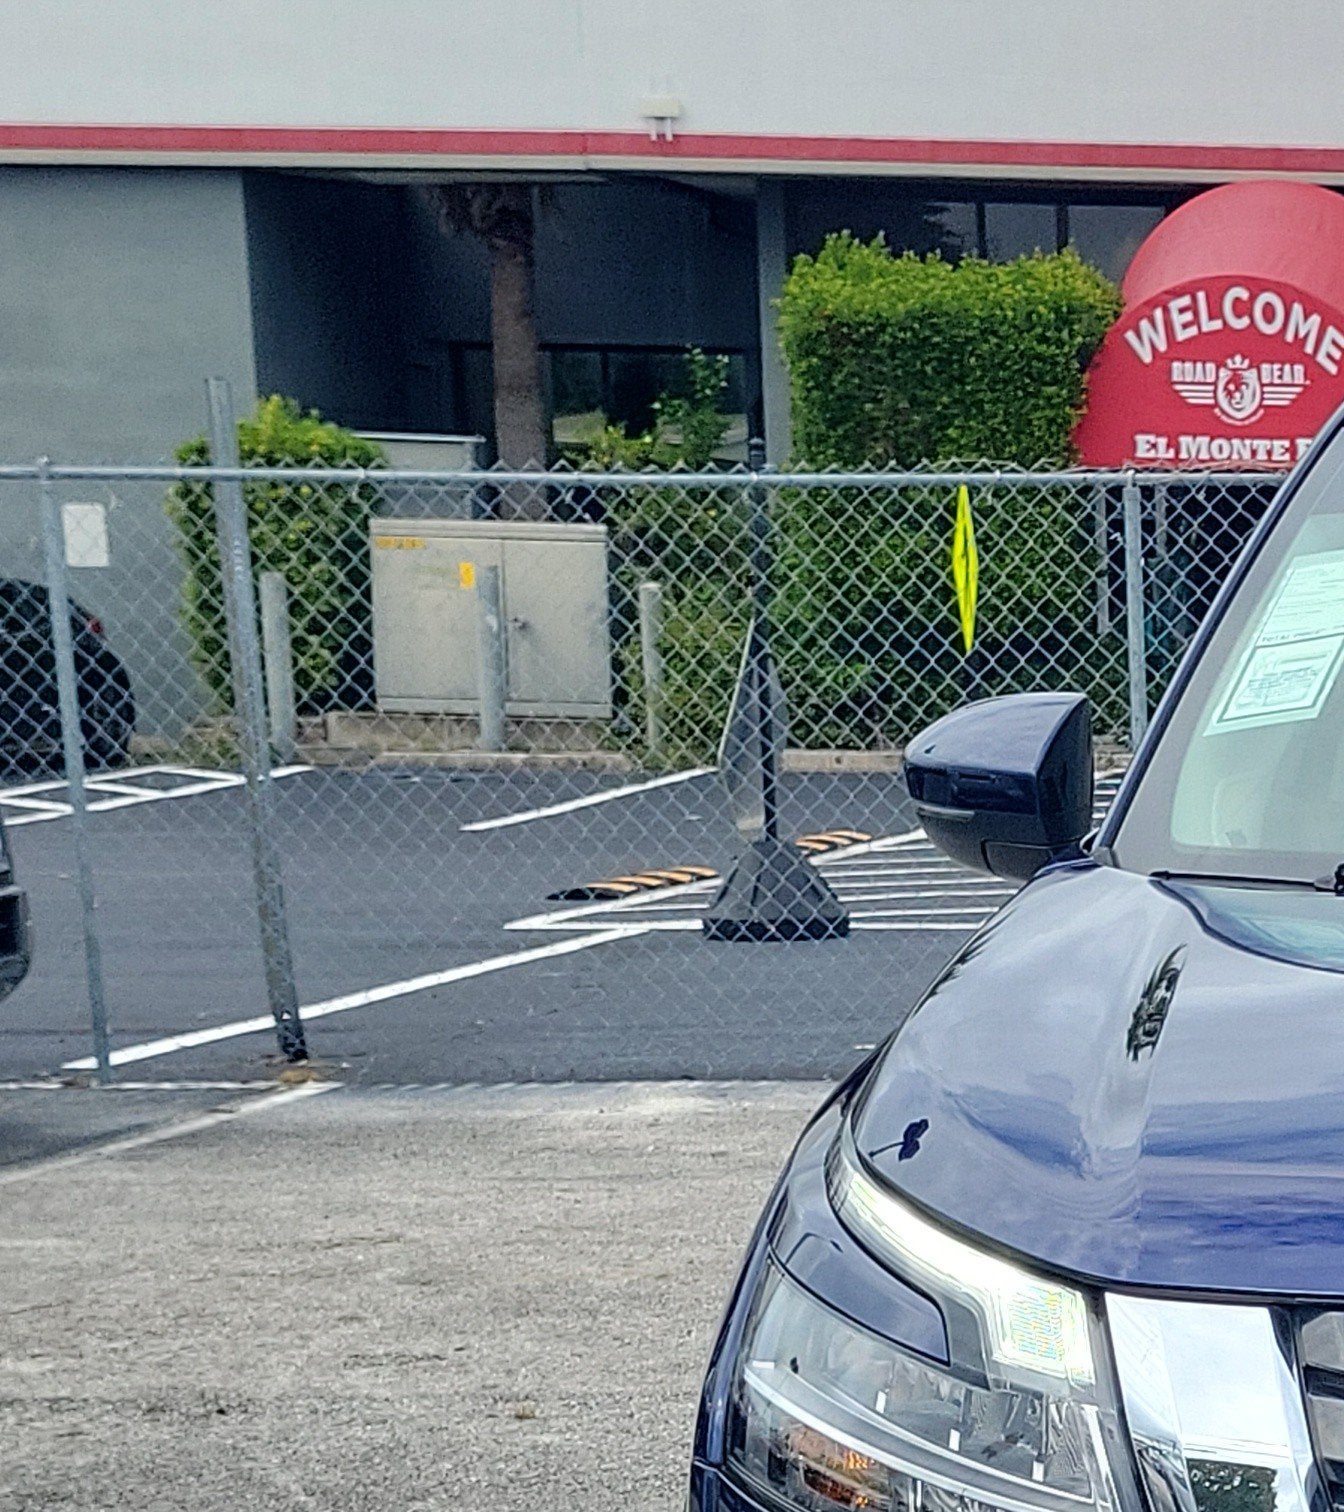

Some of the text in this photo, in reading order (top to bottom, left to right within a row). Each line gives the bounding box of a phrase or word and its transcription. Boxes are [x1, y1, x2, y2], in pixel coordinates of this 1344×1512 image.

[1171, 361, 1216, 382] ROAD
[1134, 434, 1175, 459] EL
[1178, 435, 1290, 461] MONTE
